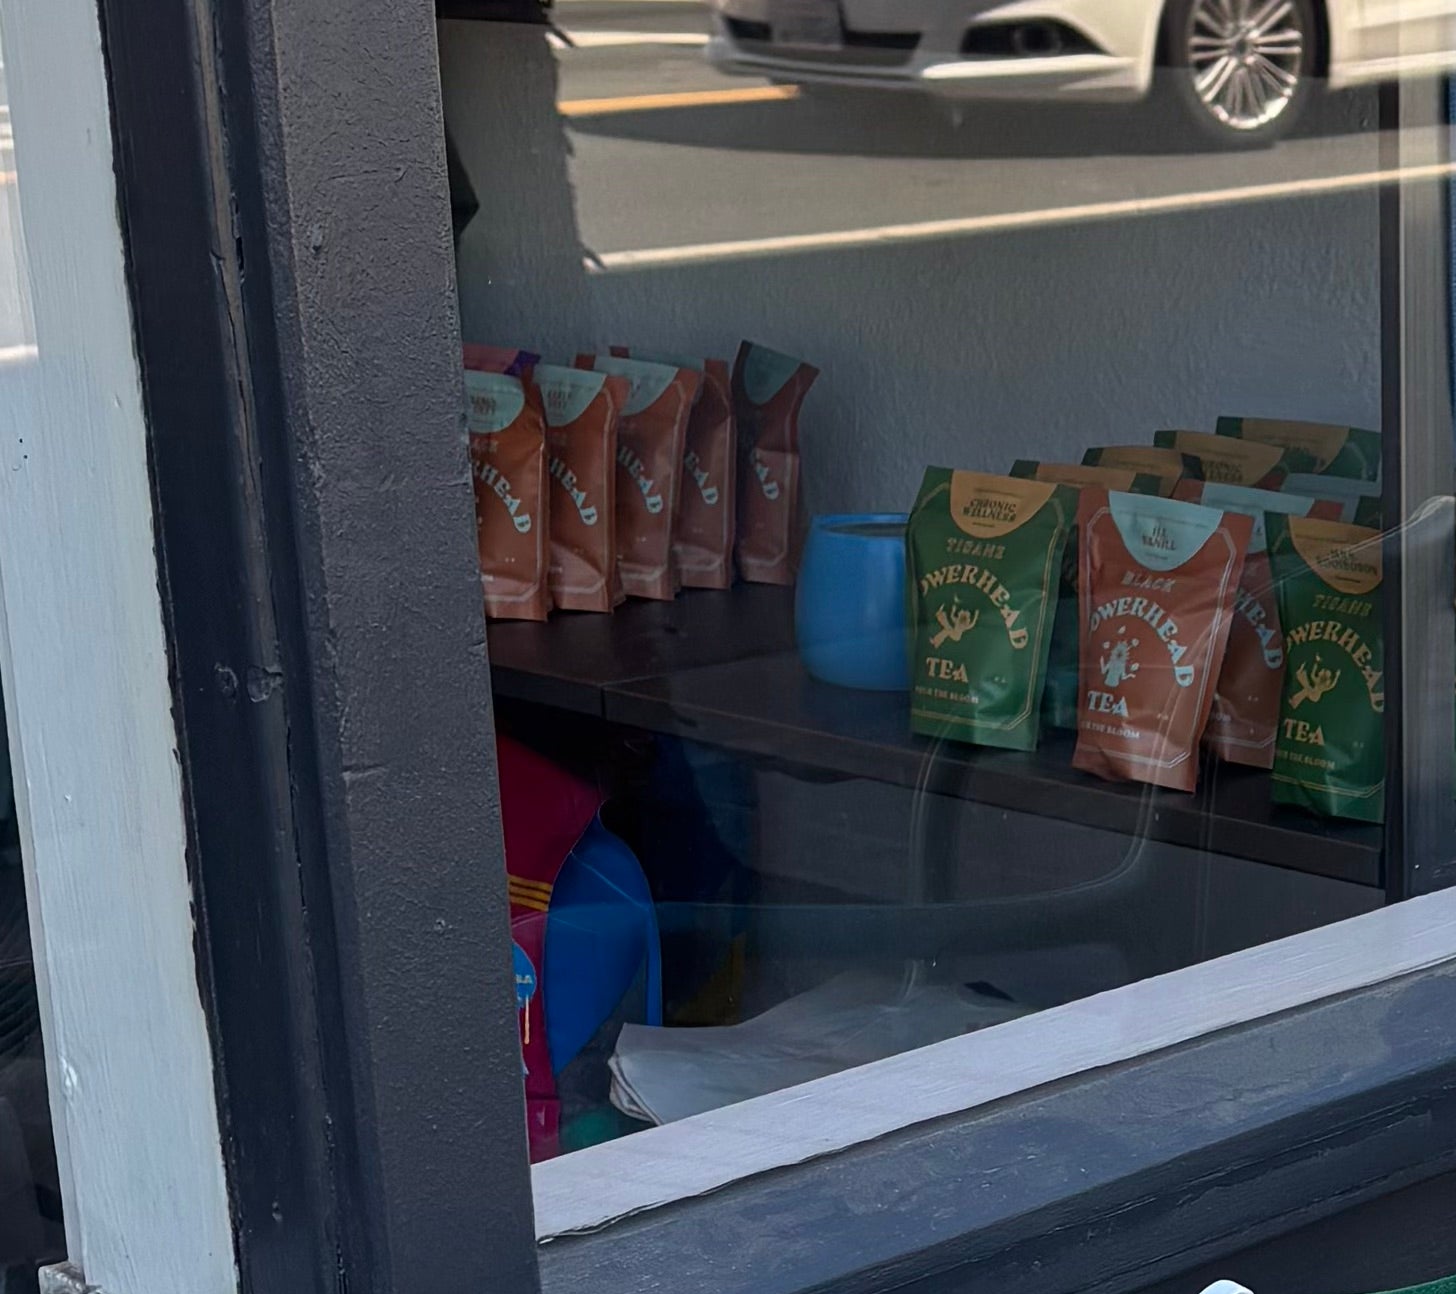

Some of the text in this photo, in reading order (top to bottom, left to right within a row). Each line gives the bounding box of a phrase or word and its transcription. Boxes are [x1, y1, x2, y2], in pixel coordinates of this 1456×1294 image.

[926, 657, 969, 683] TEA
[1087, 690, 1129, 718] TEA
[1284, 718, 1326, 746] TEA
